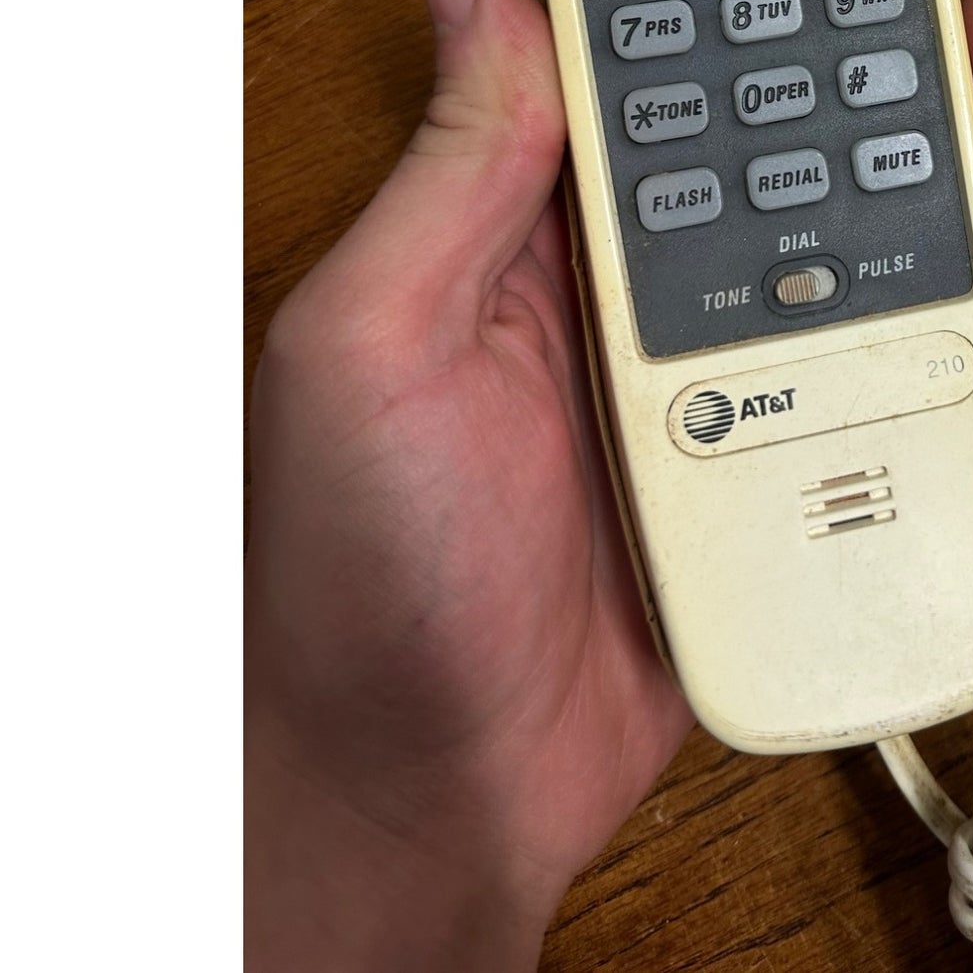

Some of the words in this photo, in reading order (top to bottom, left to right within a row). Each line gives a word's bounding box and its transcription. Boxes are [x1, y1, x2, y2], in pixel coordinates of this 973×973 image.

[731, 1, 752, 31] 8
[757, 0, 792, 20] TUV
[620, 17, 642, 47] 7
[645, 17, 682, 38] PRS
[763, 81, 809, 104] OPER
[873, 149, 921, 173] MUTE
[758, 166, 824, 193] REDIAL
[653, 186, 712, 213] FLASH
[779, 230, 820, 253] DIAL
[858, 253, 915, 279] PULSE
[702, 285, 752, 311] TONE
[926, 354, 965, 379] 210
[740, 387, 797, 421] AT&T
